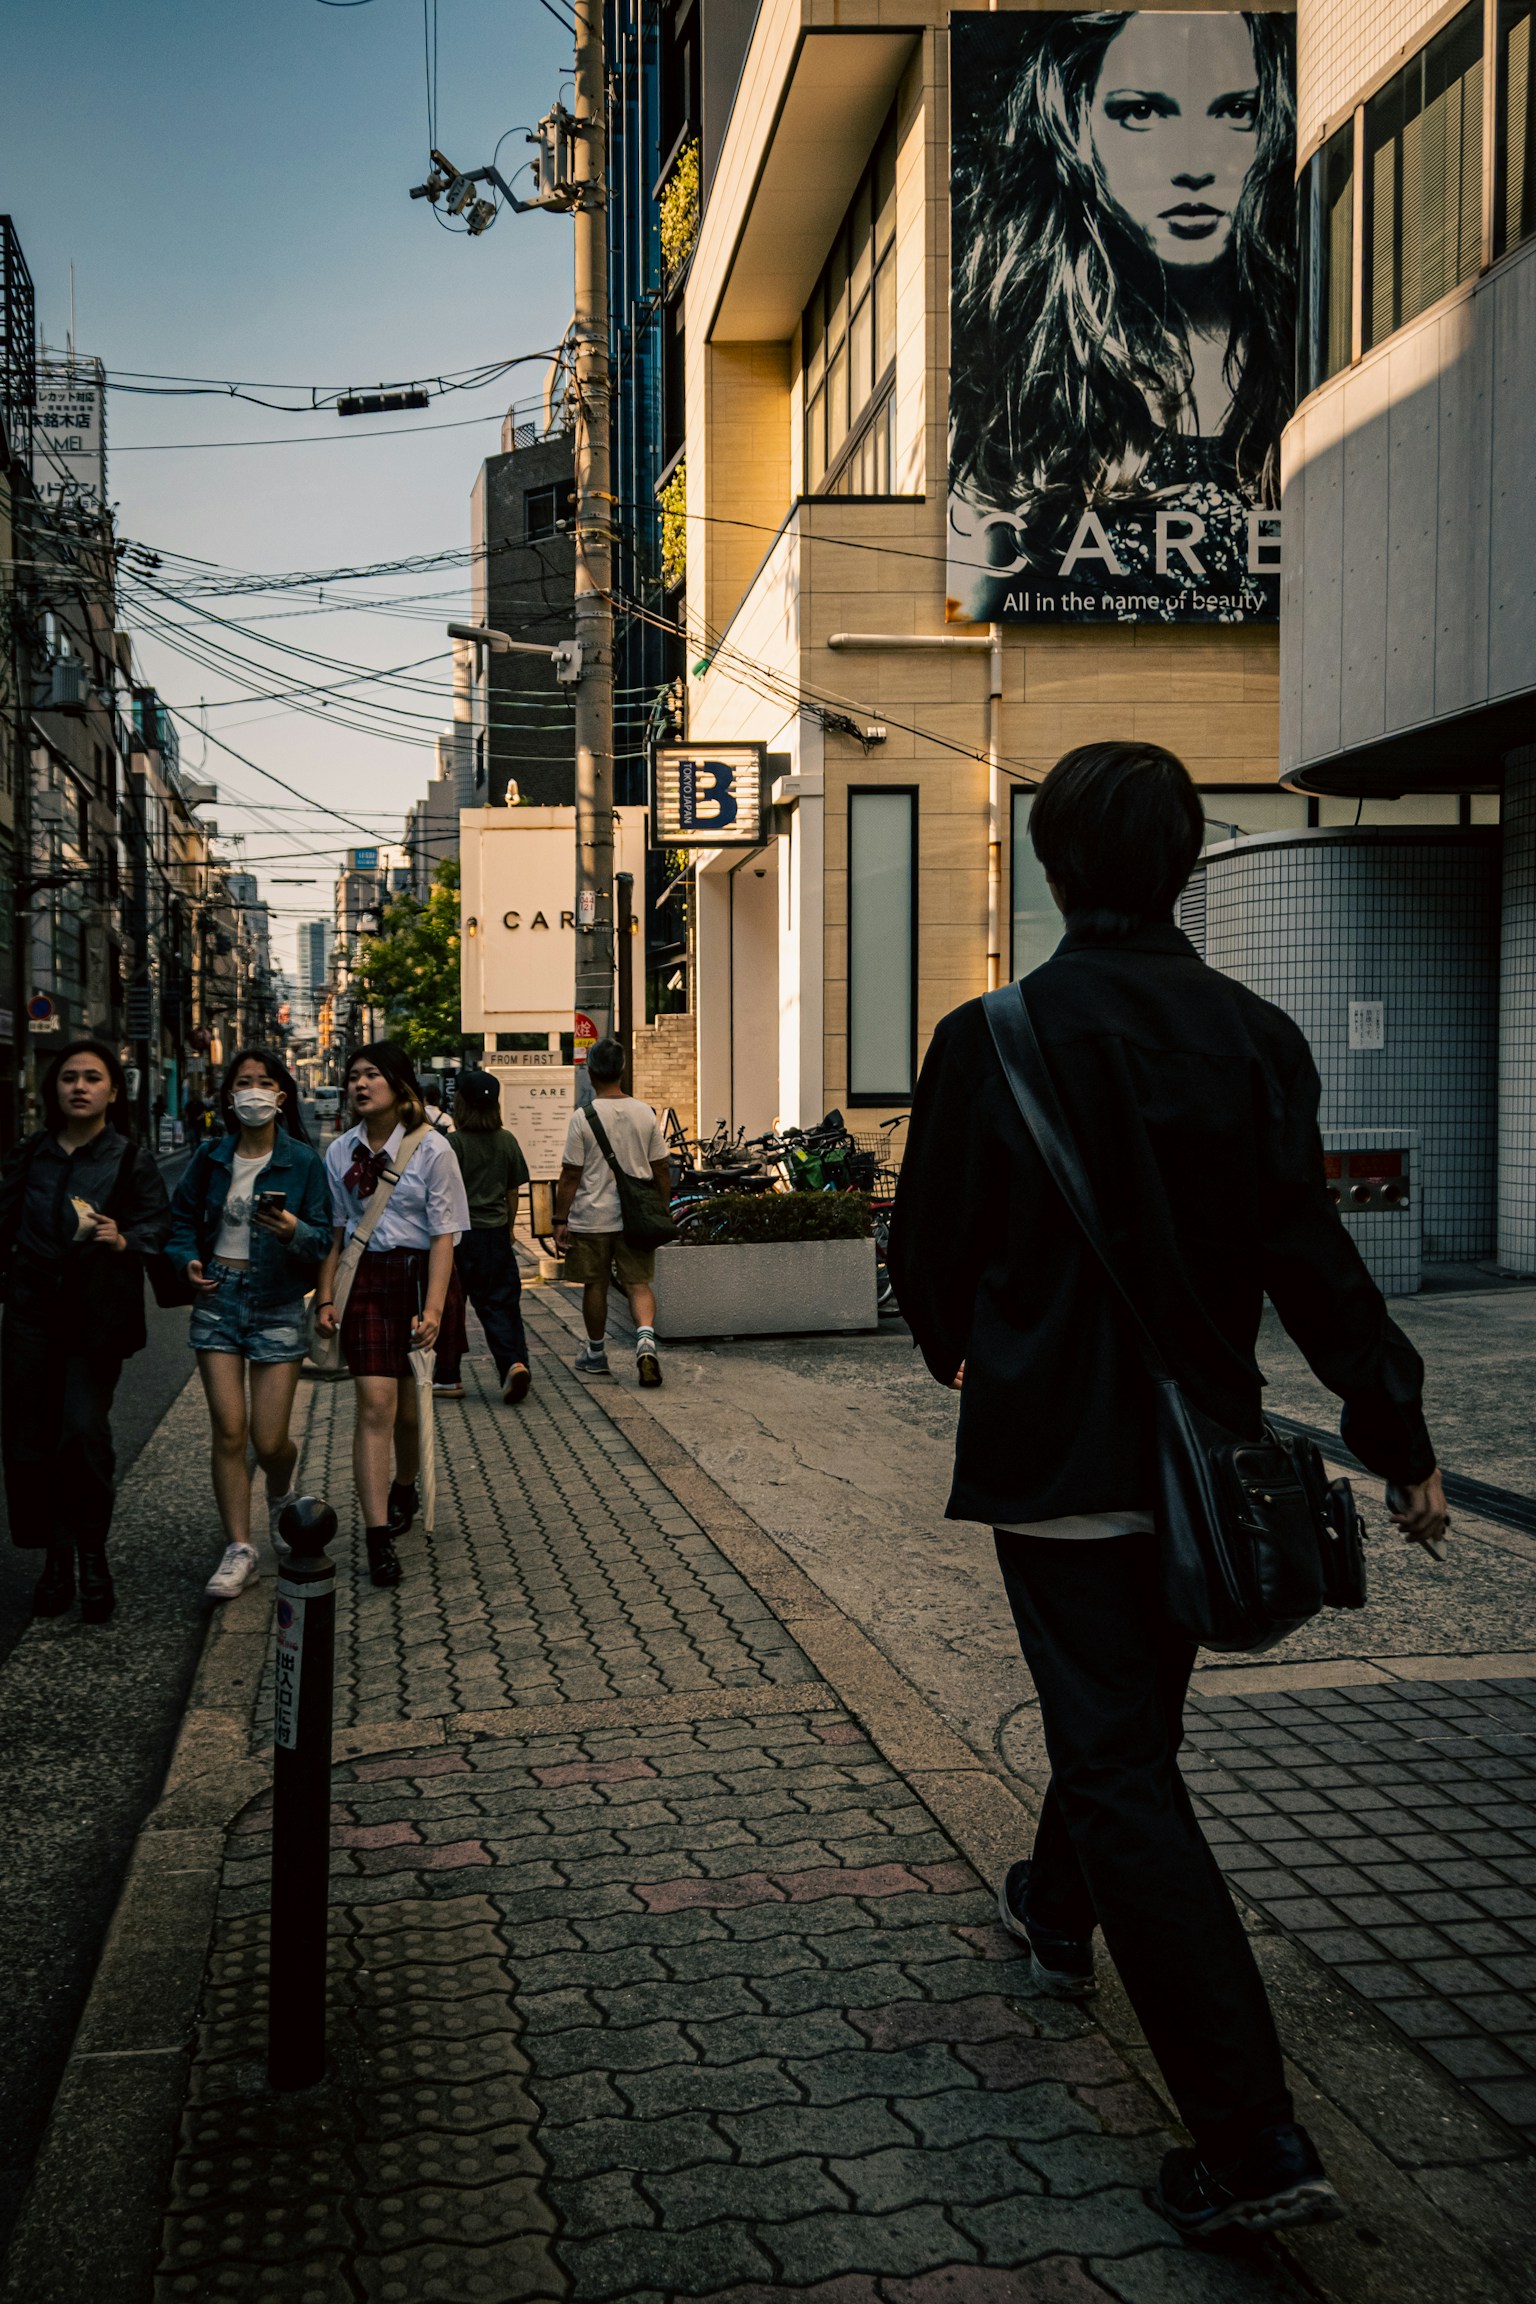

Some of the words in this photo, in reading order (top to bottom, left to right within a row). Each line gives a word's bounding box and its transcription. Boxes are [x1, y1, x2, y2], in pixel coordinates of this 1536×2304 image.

[976, 510, 1281, 579] CARE
[1003, 592, 1029, 612] All
[1036, 592, 1054, 611] in
[1062, 592, 1096, 611] the
[1101, 595, 1159, 611] name
[1165, 591, 1187, 611] of
[1193, 590, 1266, 615] beauty
[683, 763, 692, 793] TOKYO
[679, 760, 738, 829] B
[683, 795, 692, 824] JAPAN
[503, 911, 575, 930] CAR
[490, 1054, 518, 1064] FROM
[522, 1054, 554, 1064] FIRST
[529, 1088, 567, 1097] CARE
[277, 1652, 295, 1744] 出入口に付
